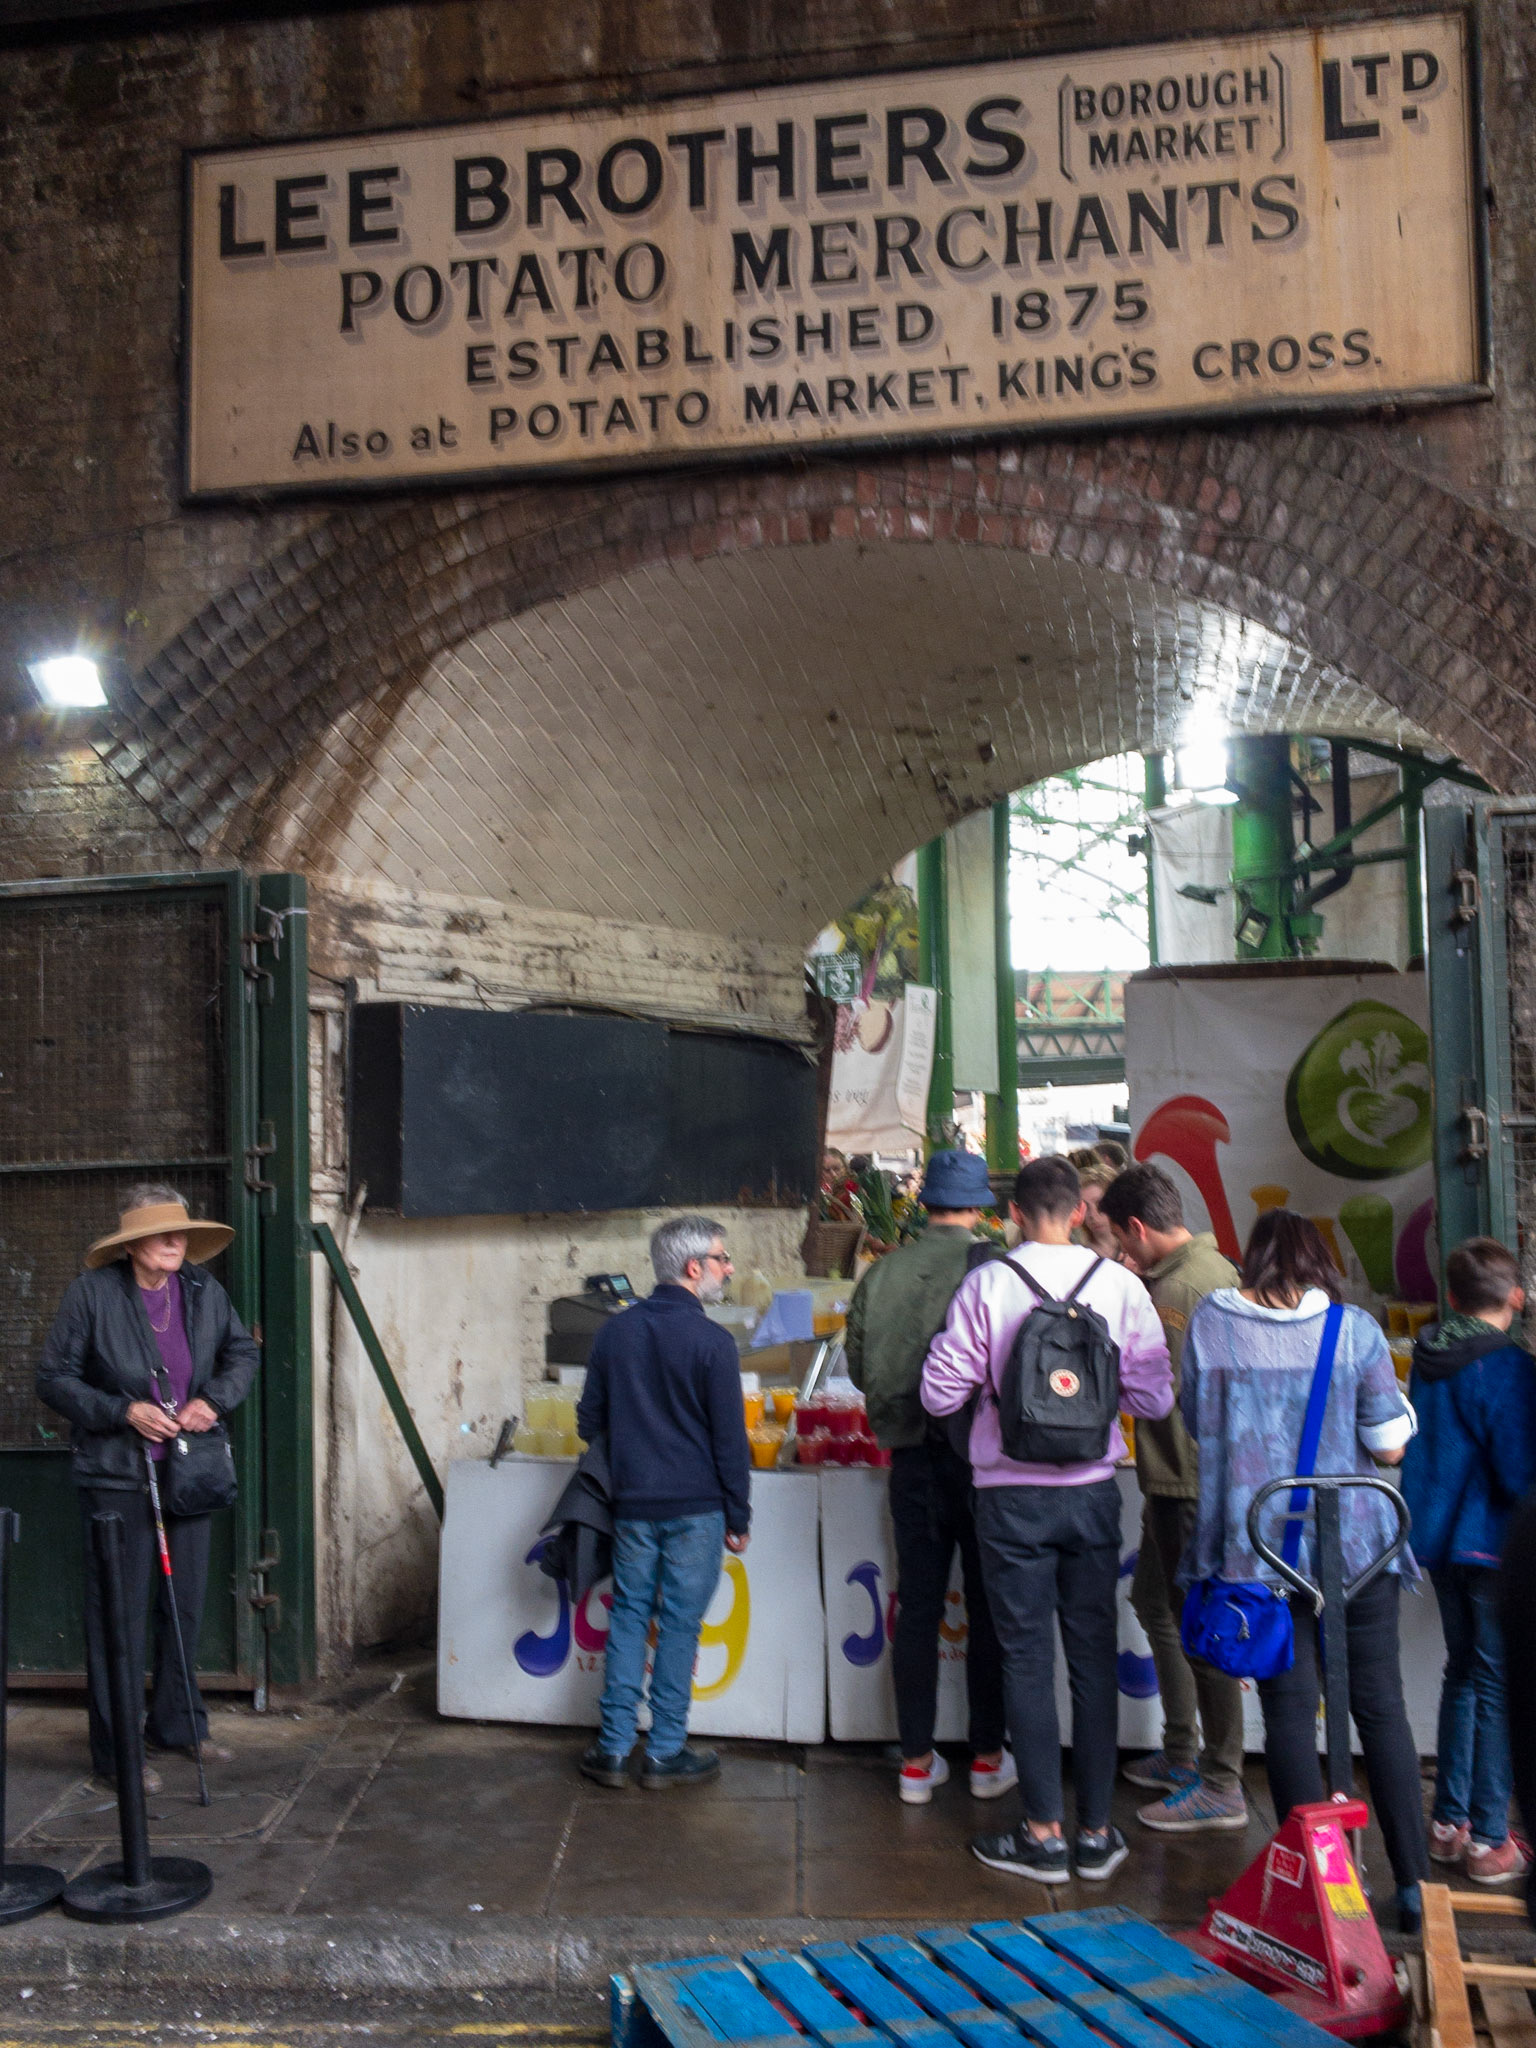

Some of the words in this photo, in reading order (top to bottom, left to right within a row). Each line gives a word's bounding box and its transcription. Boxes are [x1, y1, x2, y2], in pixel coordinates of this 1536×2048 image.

[219, 166, 400, 260] LEE
[454, 97, 1026, 236] BROTHERS
[339, 241, 666, 333] POTATO
[731, 174, 1299, 297] MERCHANTS
[293, 421, 389, 462] Also
[411, 417, 459, 450] at
[490, 391, 710, 445] POTATO
[999, 341, 1158, 398] KING'S
[467, 303, 934, 384] ESTABLISHED
[992, 280, 1149, 335] 1875
